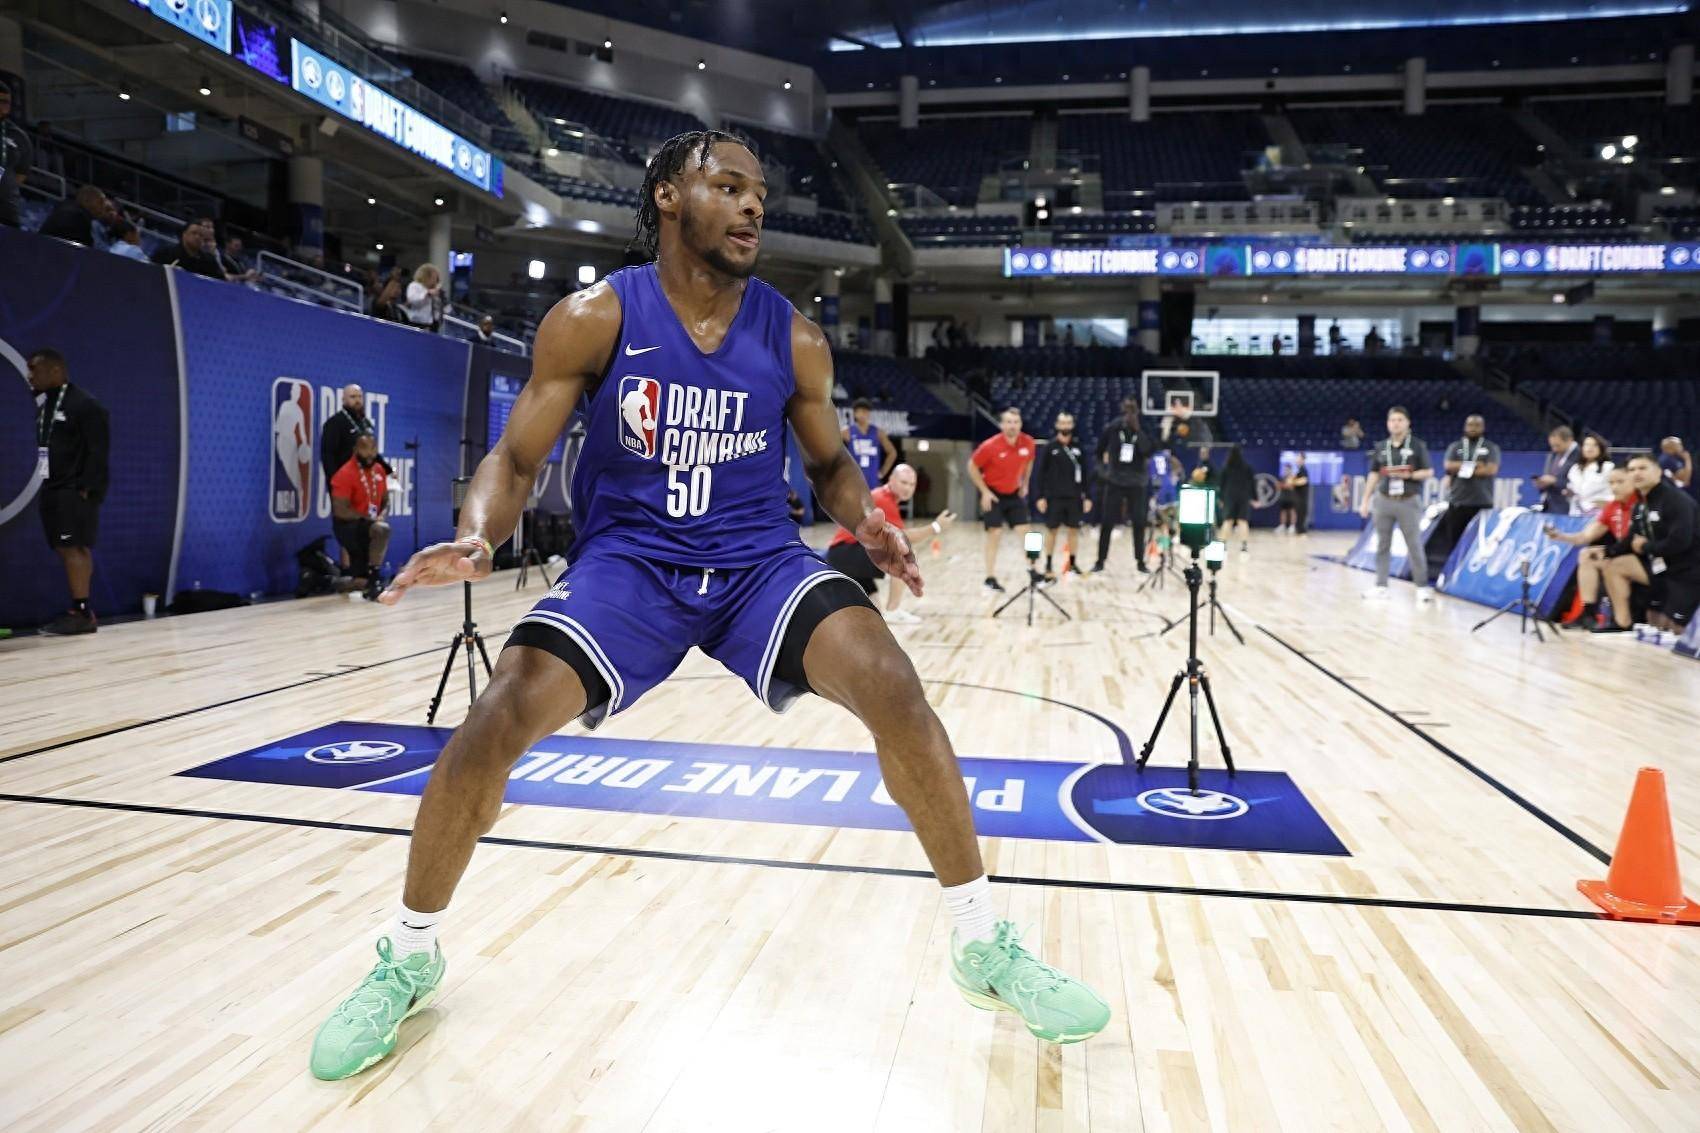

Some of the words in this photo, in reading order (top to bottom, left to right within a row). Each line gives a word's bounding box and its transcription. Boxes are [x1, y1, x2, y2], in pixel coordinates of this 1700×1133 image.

[364, 82, 404, 144] DRAFT
[1062, 249, 1101, 273] DRAFT
[1102, 249, 1159, 273] COMBINE
[1306, 248, 1347, 272] DRAFT
[1348, 247, 1408, 272] COMBINE
[1559, 246, 1602, 271] DRAFT
[1602, 245, 1666, 270] COMBINE
[320, 386, 389, 454] DFT
[665, 383, 749, 432] DRAFT
[624, 435, 643, 450] NBA
[666, 464, 712, 518] 50
[508, 751, 675, 789] DRIL
[661, 762, 861, 803] LANE
